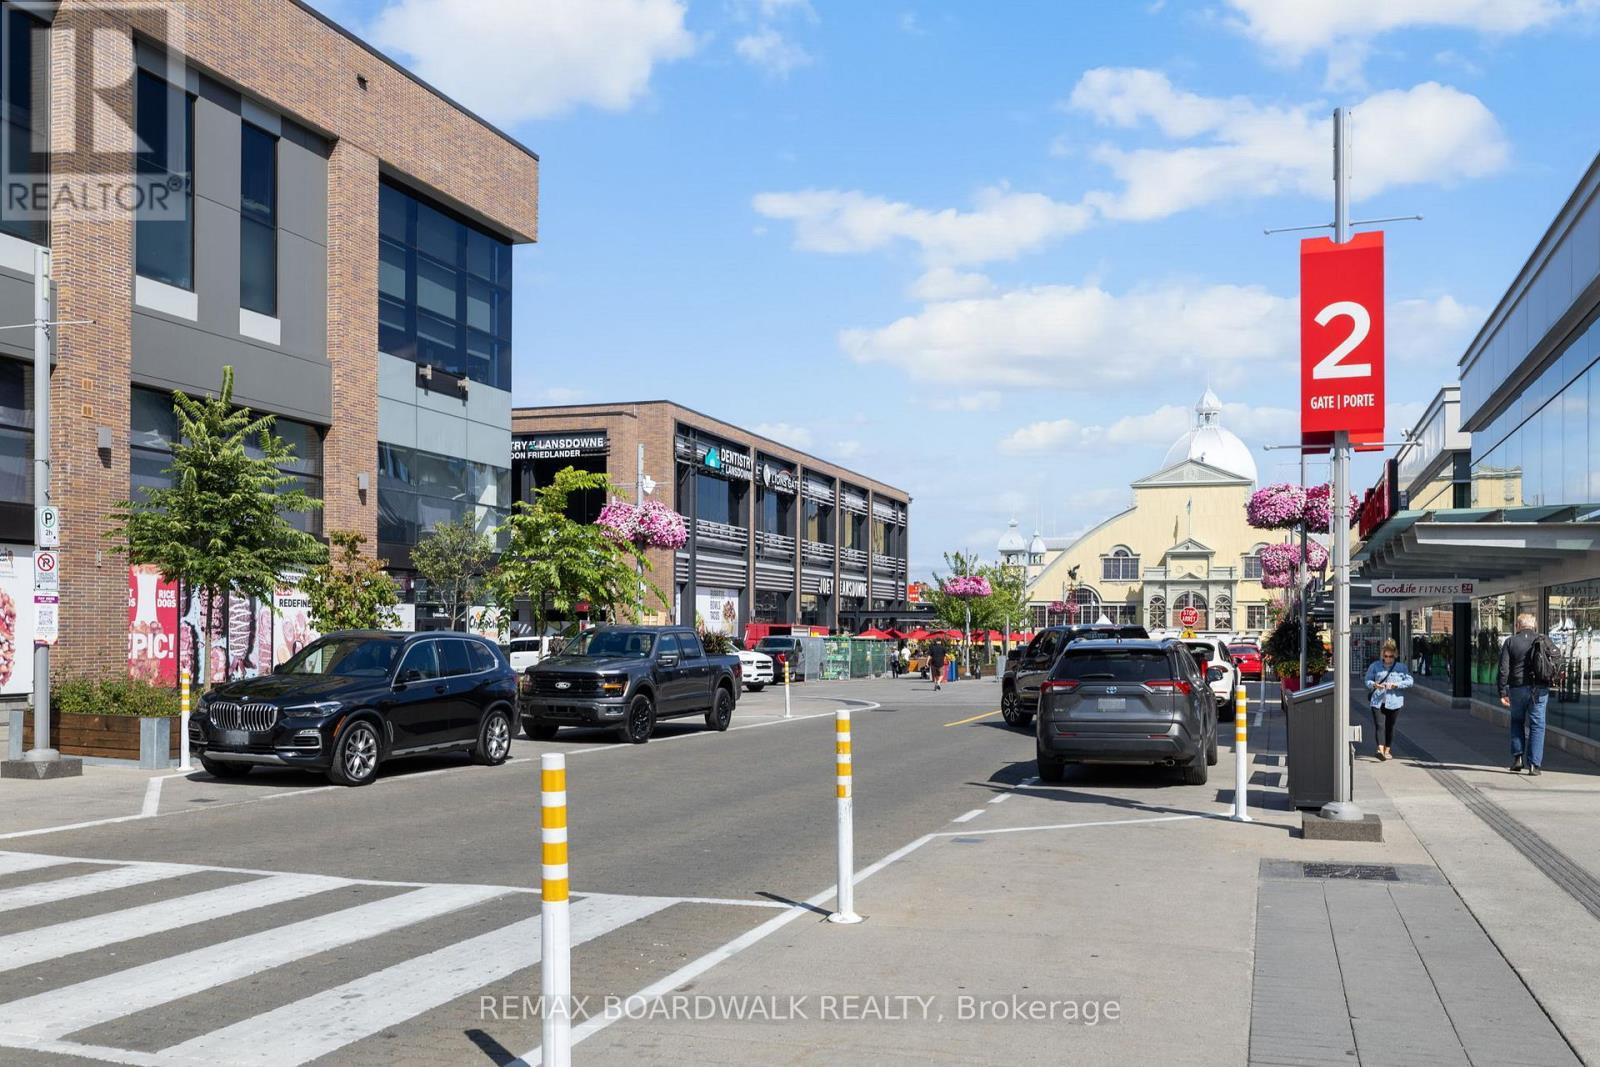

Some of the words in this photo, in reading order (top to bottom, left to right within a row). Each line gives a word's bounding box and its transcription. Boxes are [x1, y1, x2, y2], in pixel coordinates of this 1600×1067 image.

[1312, 300, 1372, 380] 2
[1310, 395, 1335, 410] GATE
[1343, 393, 1375, 408] PORTE
[539, 437, 604, 449] LANSDOWNE
[527, 449, 581, 460] FRIEDLANDER
[721, 447, 754, 472] DENTISTRY
[45, 512, 53, 525] P
[818, 577, 834, 595] JOEY
[1376, 583, 1417, 594] GoodLife
[1418, 585, 1459, 594] FITNESS
[157, 589, 176, 599] RICE
[157, 598, 177, 608] DOGS
